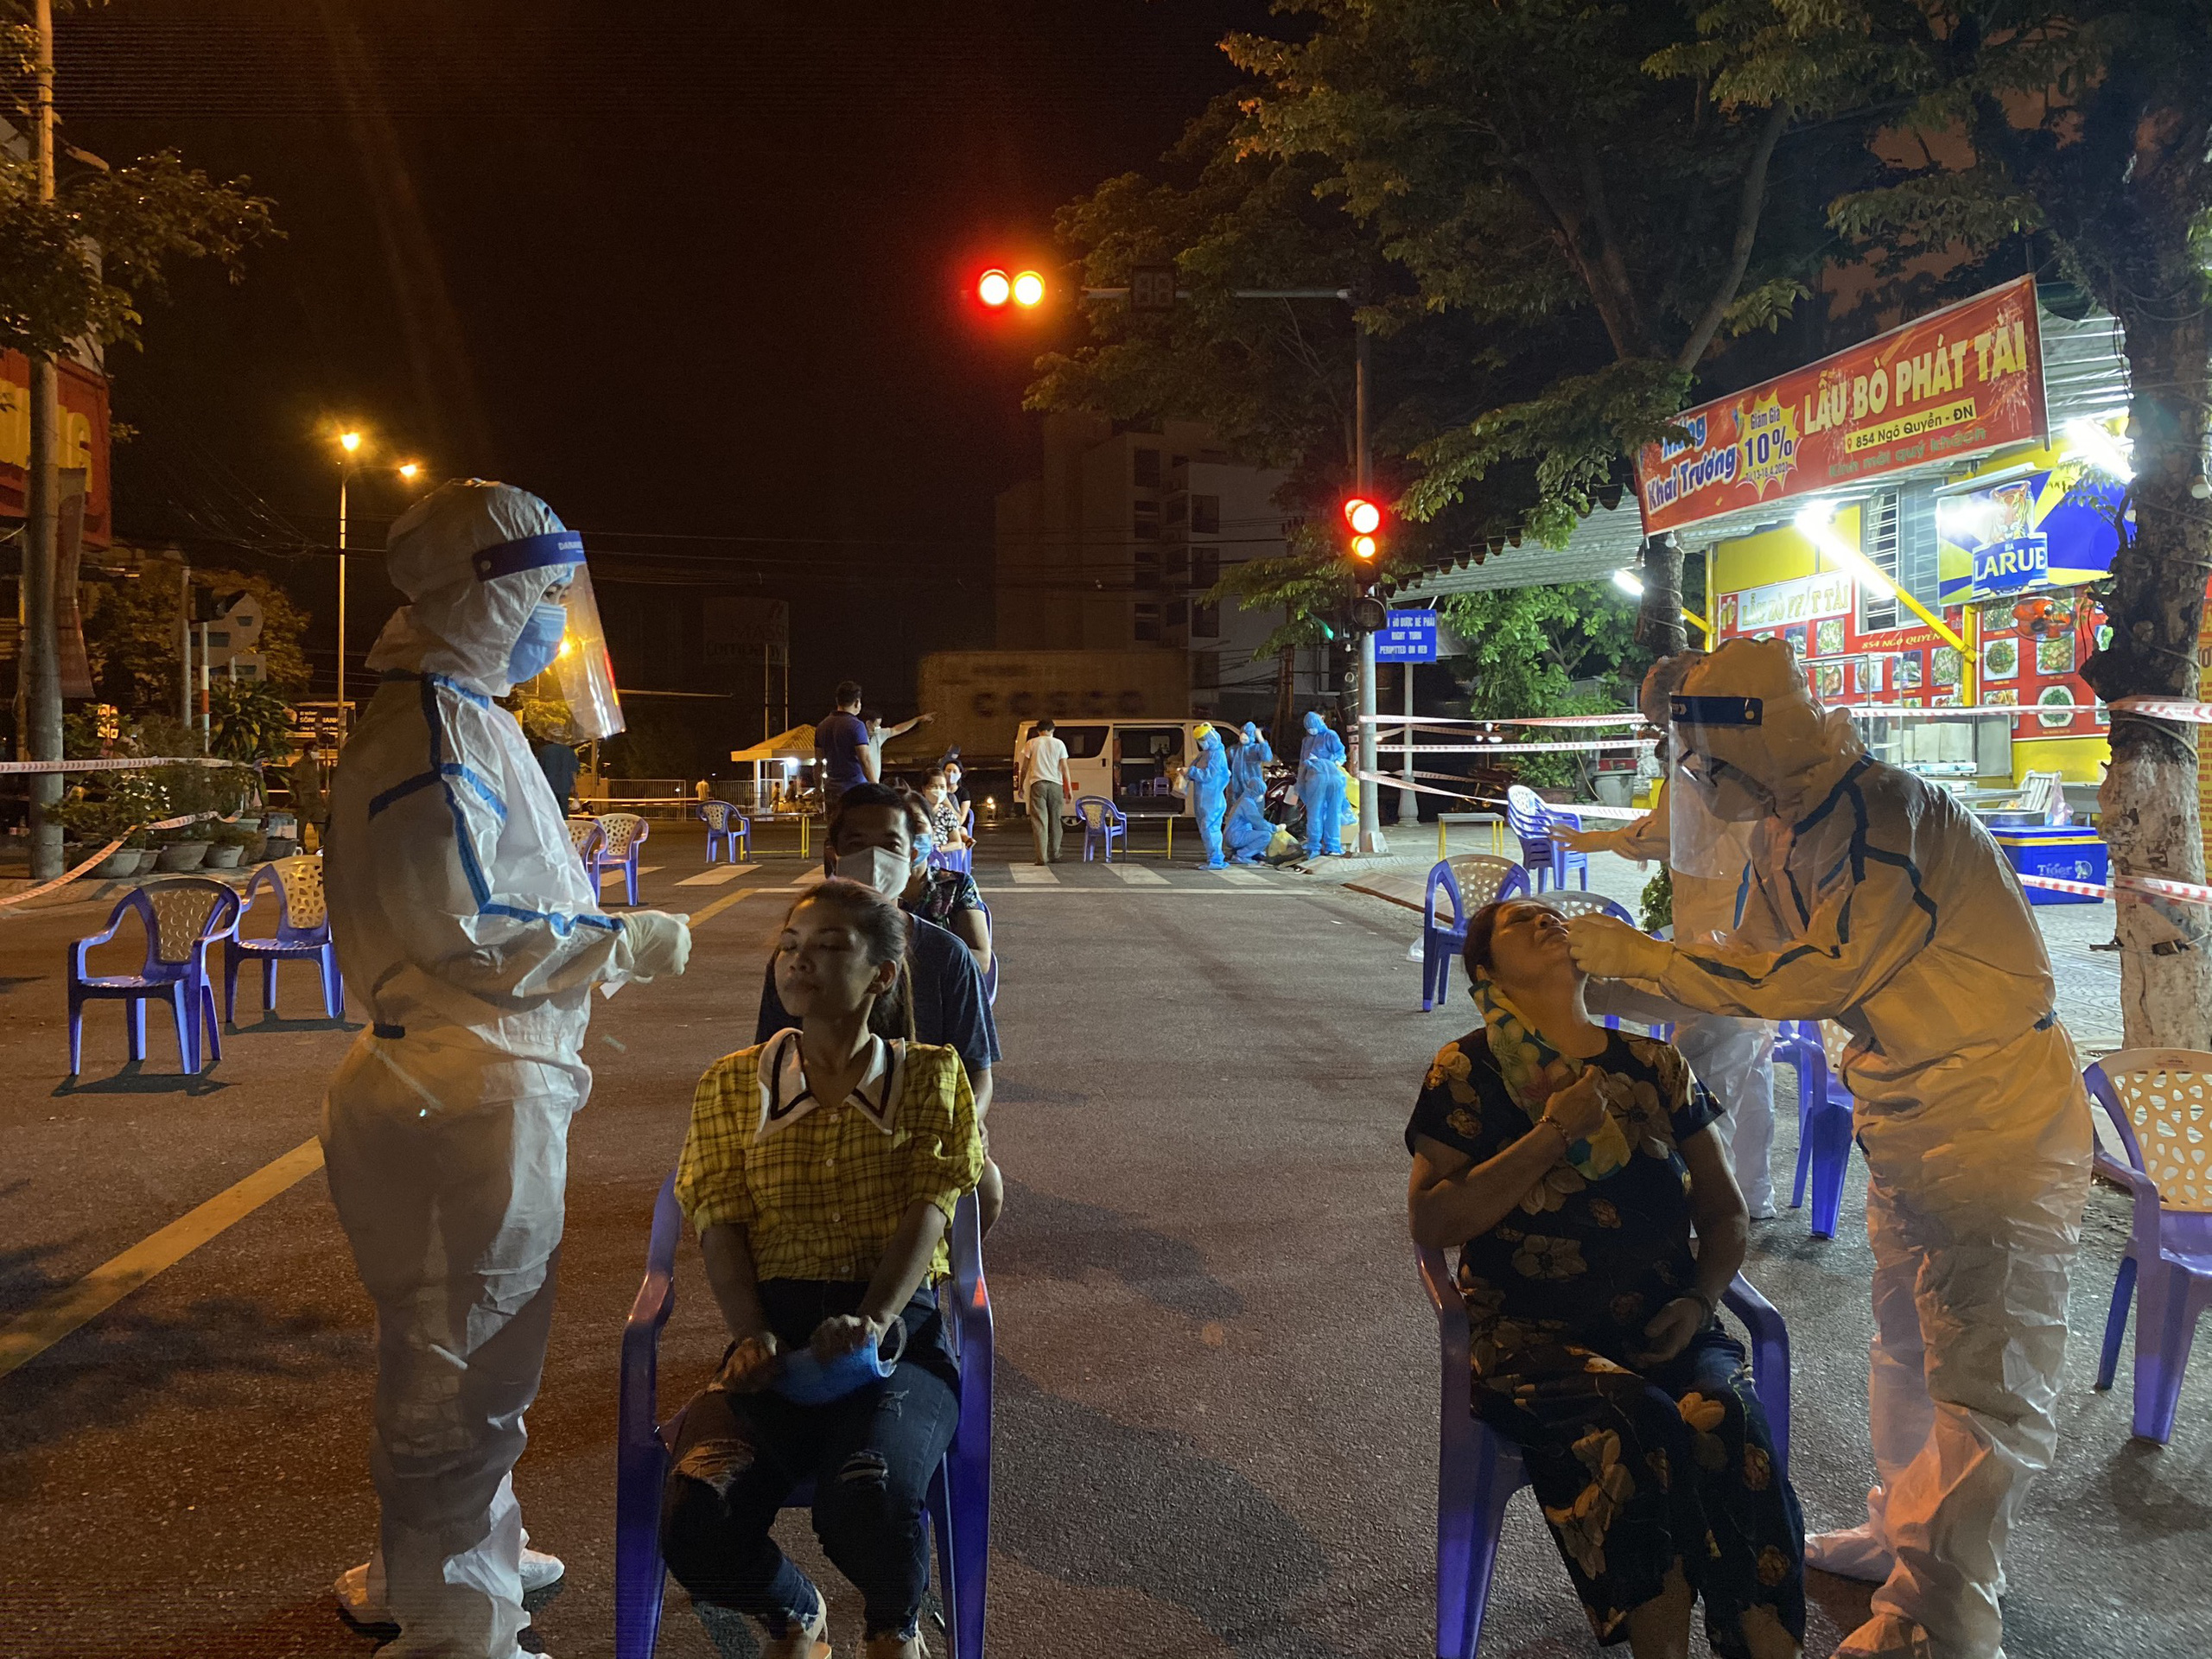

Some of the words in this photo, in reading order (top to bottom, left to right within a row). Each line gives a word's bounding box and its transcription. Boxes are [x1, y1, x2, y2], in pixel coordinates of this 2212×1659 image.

[1853, 356, 1888, 420] BÒ
[1896, 334, 1968, 406] PHÁT
[1974, 308, 2027, 382] TÀI
[1745, 426, 1792, 467] 10%
[1856, 434, 1875, 448] 854
[1878, 425, 1900, 442] Ngô
[1904, 412, 1942, 434] Quyền
[1954, 405, 1974, 421] ĐN
[1646, 465, 1678, 515] Khai
[1974, 547, 2046, 582] LARUE
[1862, 639, 1879, 648] 854
